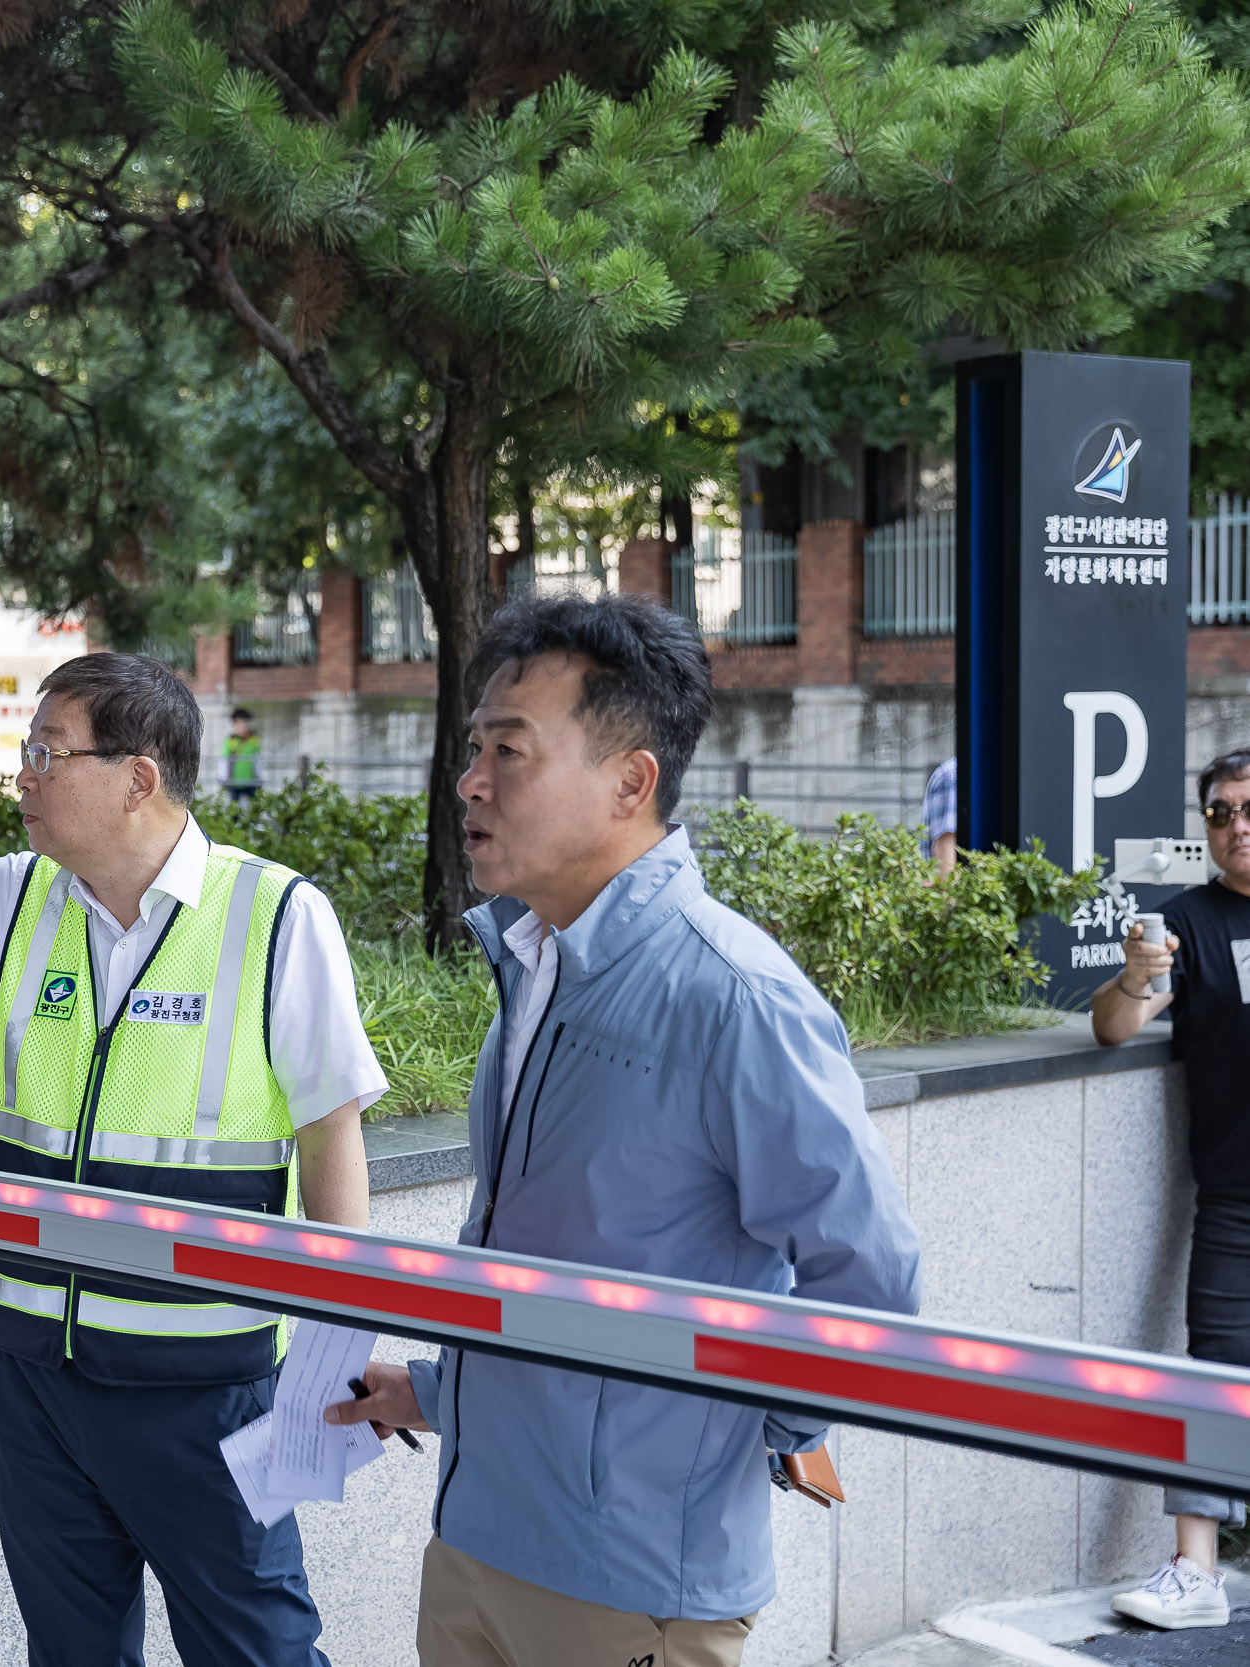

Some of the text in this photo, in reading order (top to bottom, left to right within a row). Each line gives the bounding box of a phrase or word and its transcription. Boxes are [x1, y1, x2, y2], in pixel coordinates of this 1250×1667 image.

[1044, 514, 1169, 546] 광진구시설관리공단
[1044, 555, 1168, 586] 자양문화체육센터
[1063, 691, 1149, 873] P
[1070, 941, 1128, 970] PARKIN
[40, 1002, 70, 1015] 광진구
[150, 1009, 201, 1021] 광진구청장
